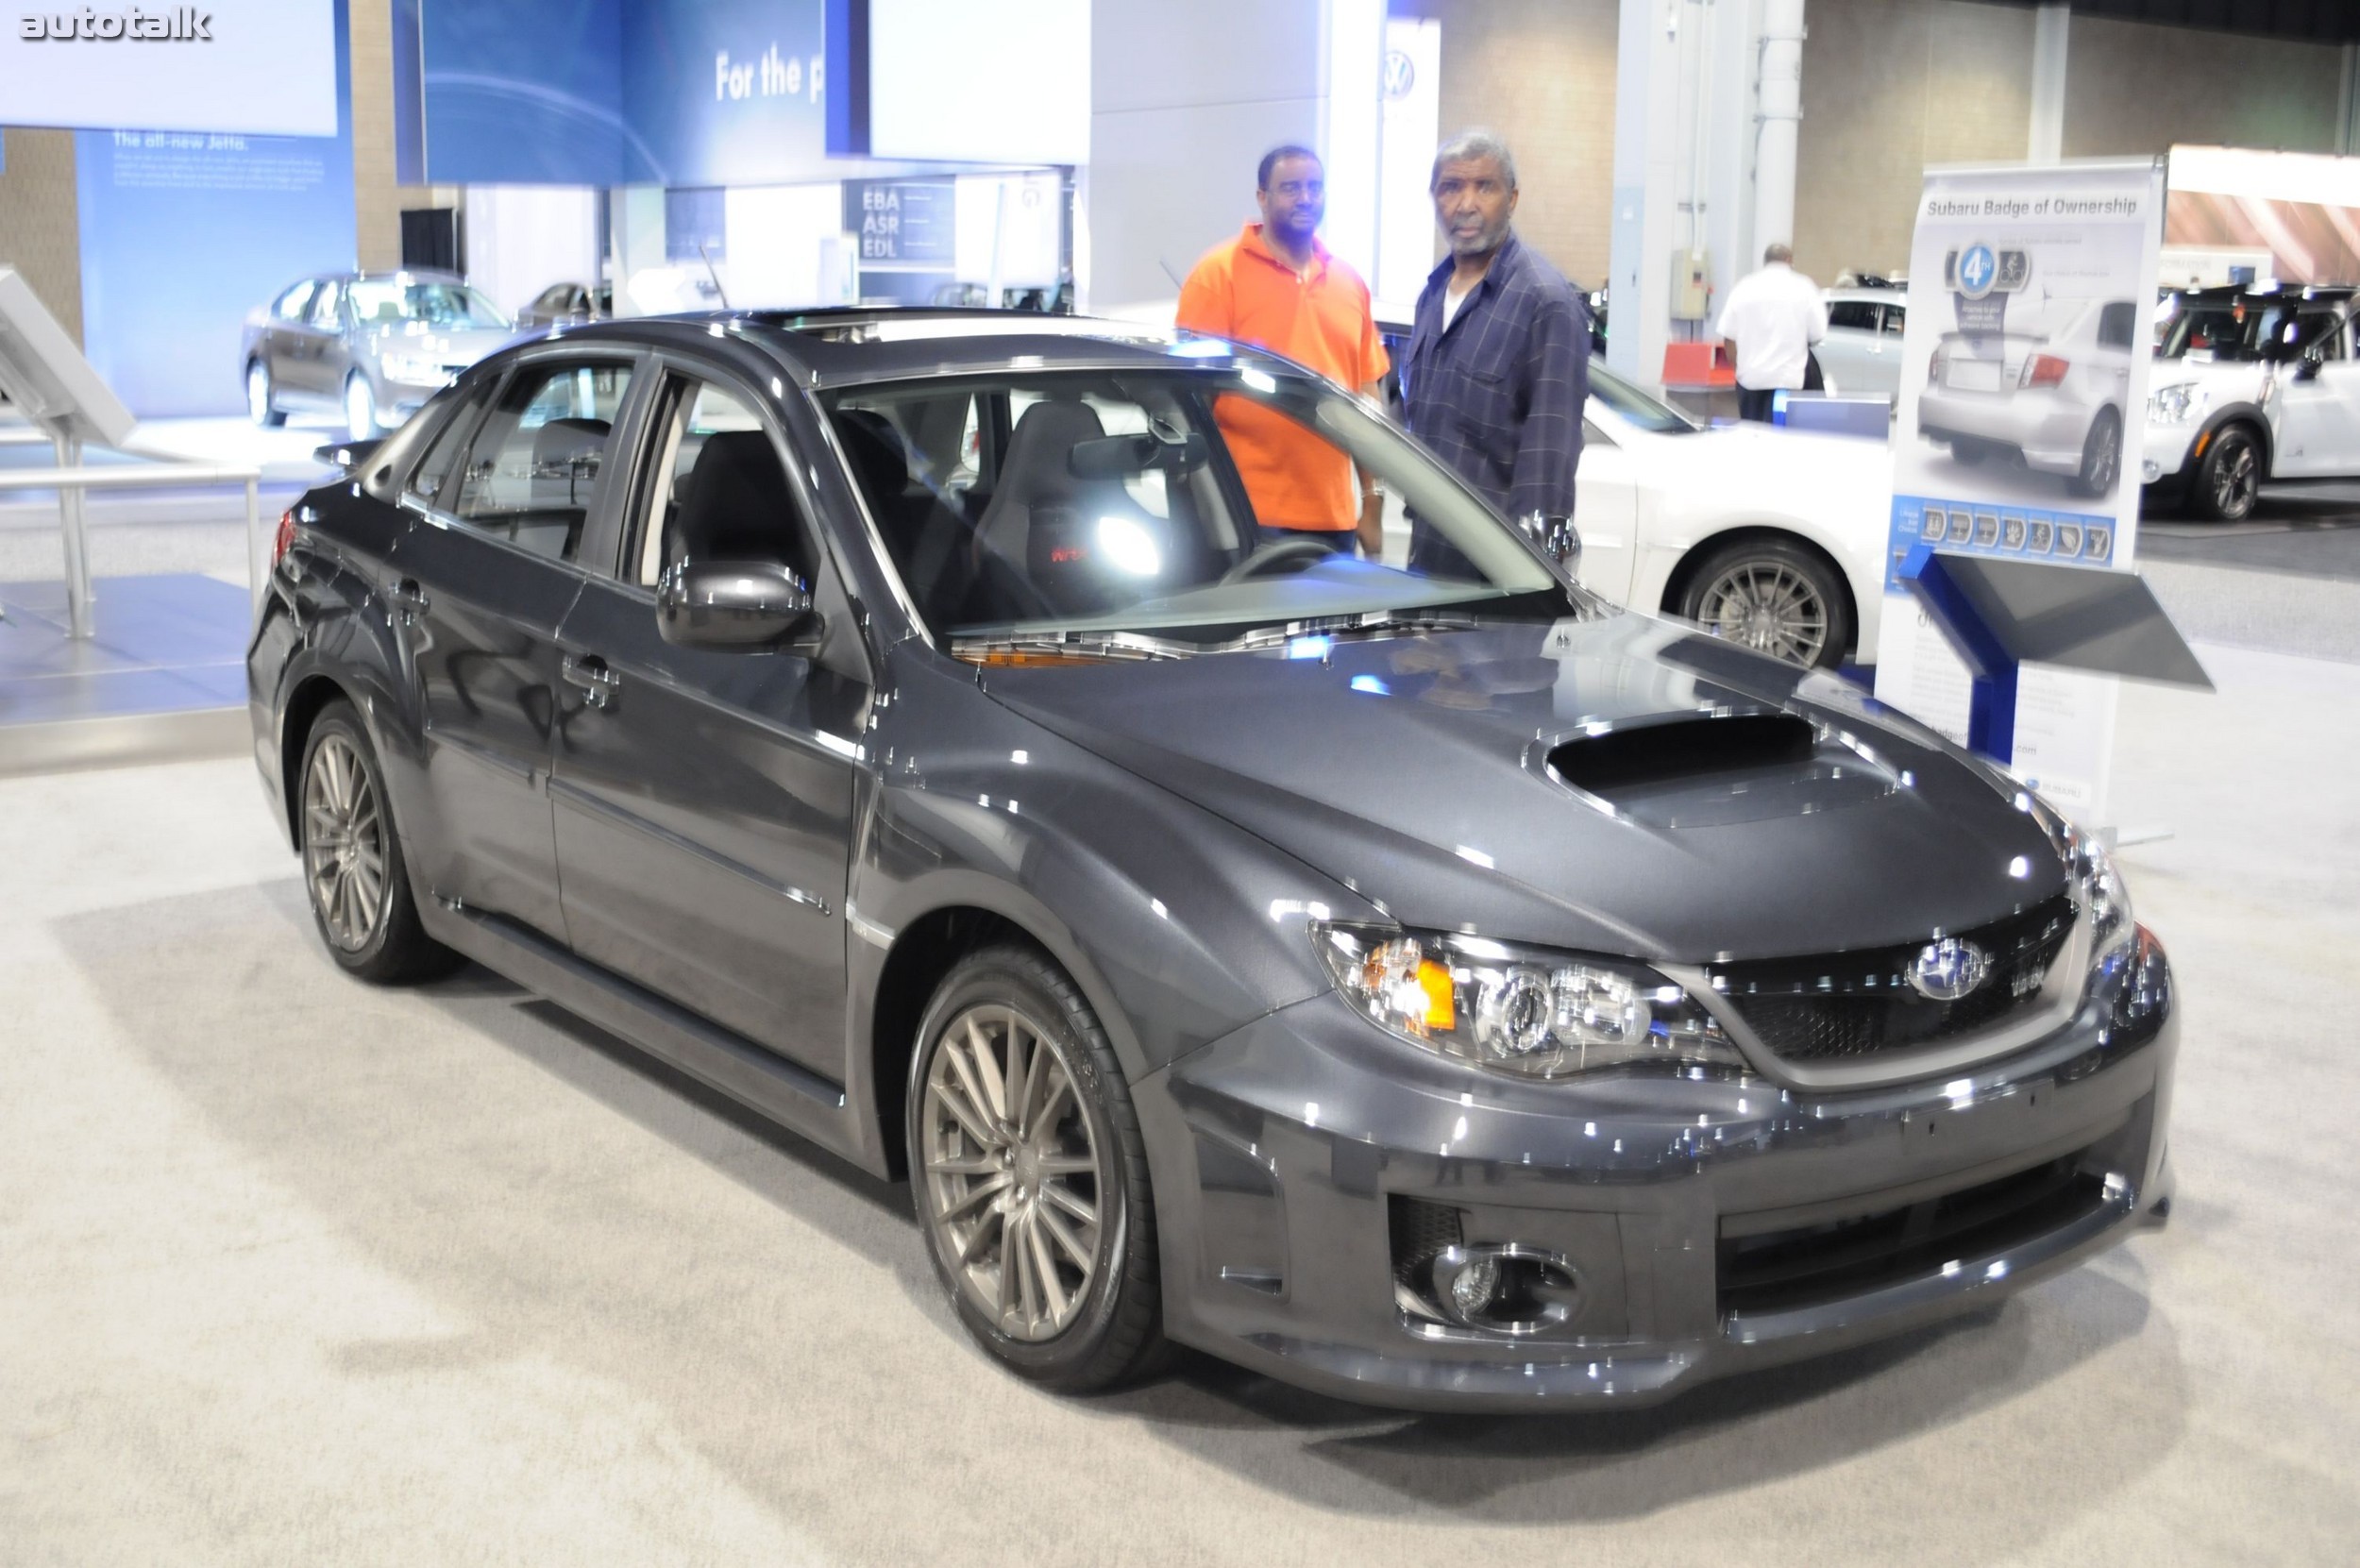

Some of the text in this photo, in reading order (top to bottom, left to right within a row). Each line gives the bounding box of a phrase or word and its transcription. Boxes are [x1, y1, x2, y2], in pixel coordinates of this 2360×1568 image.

[716, 40, 825, 105] For the p
[113, 131, 249, 151] The all-new Jetta.
[863, 190, 900, 211] EBA
[1928, 197, 2137, 219] Subaru Badge of Ownership
[863, 214, 900, 235] ASR
[863, 238, 898, 258] EDL
